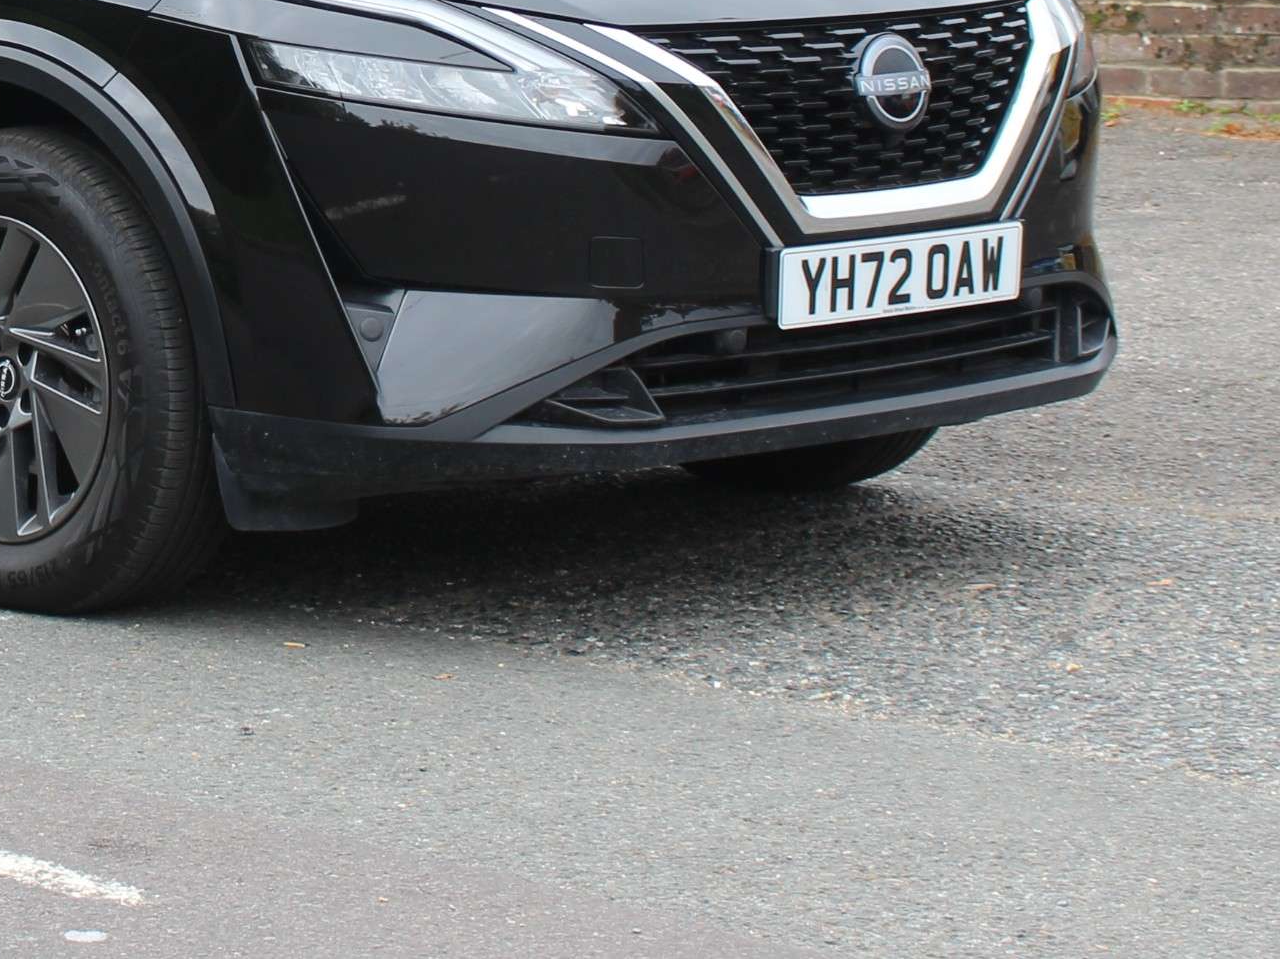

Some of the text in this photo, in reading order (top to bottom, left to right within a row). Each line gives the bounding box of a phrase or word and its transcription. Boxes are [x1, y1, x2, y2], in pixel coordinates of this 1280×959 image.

[860, 75, 931, 92] NISSAN
[801, 236, 1005, 316] YH72 OAW
